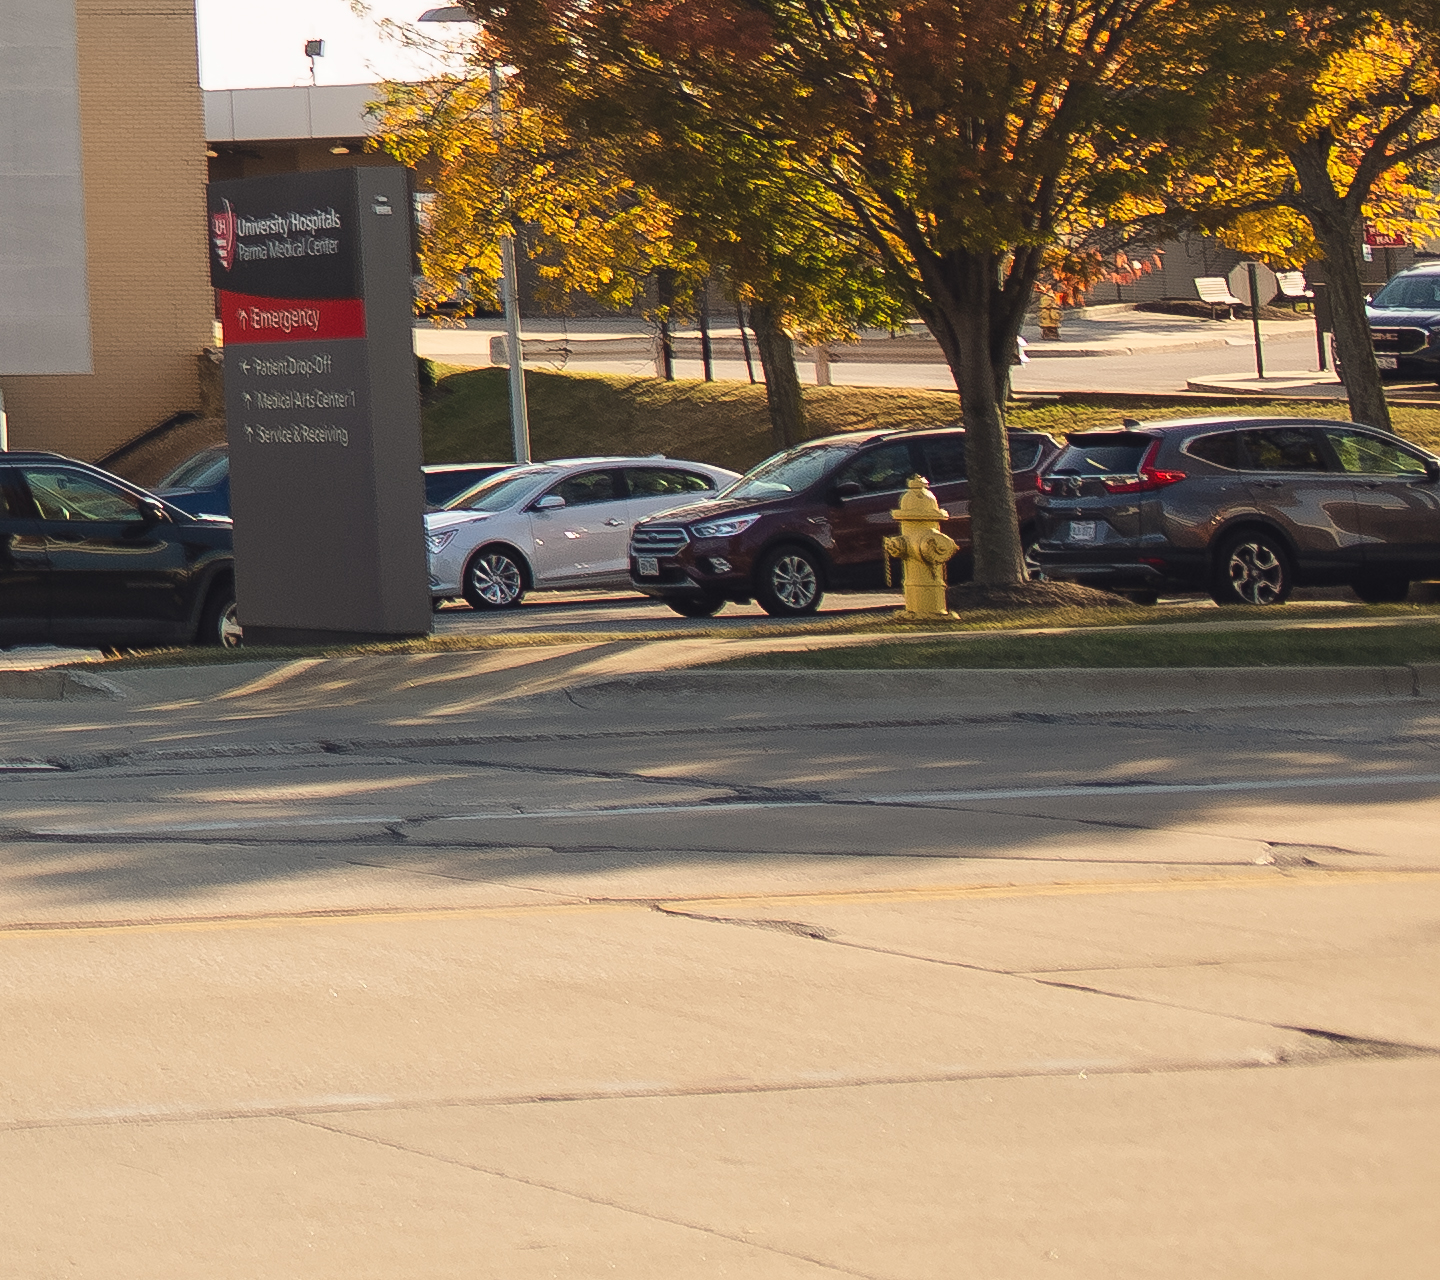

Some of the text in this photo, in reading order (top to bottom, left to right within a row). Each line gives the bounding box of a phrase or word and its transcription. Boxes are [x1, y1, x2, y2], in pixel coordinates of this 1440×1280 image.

[236, 206, 341, 237] University Hospitals
[237, 236, 339, 261] Parma Medical Center
[251, 306, 320, 333] Emergency
[255, 389, 293, 409] Medical
[315, 389, 348, 408] Center
[257, 424, 292, 443] Service
[300, 423, 349, 447] Receiving
